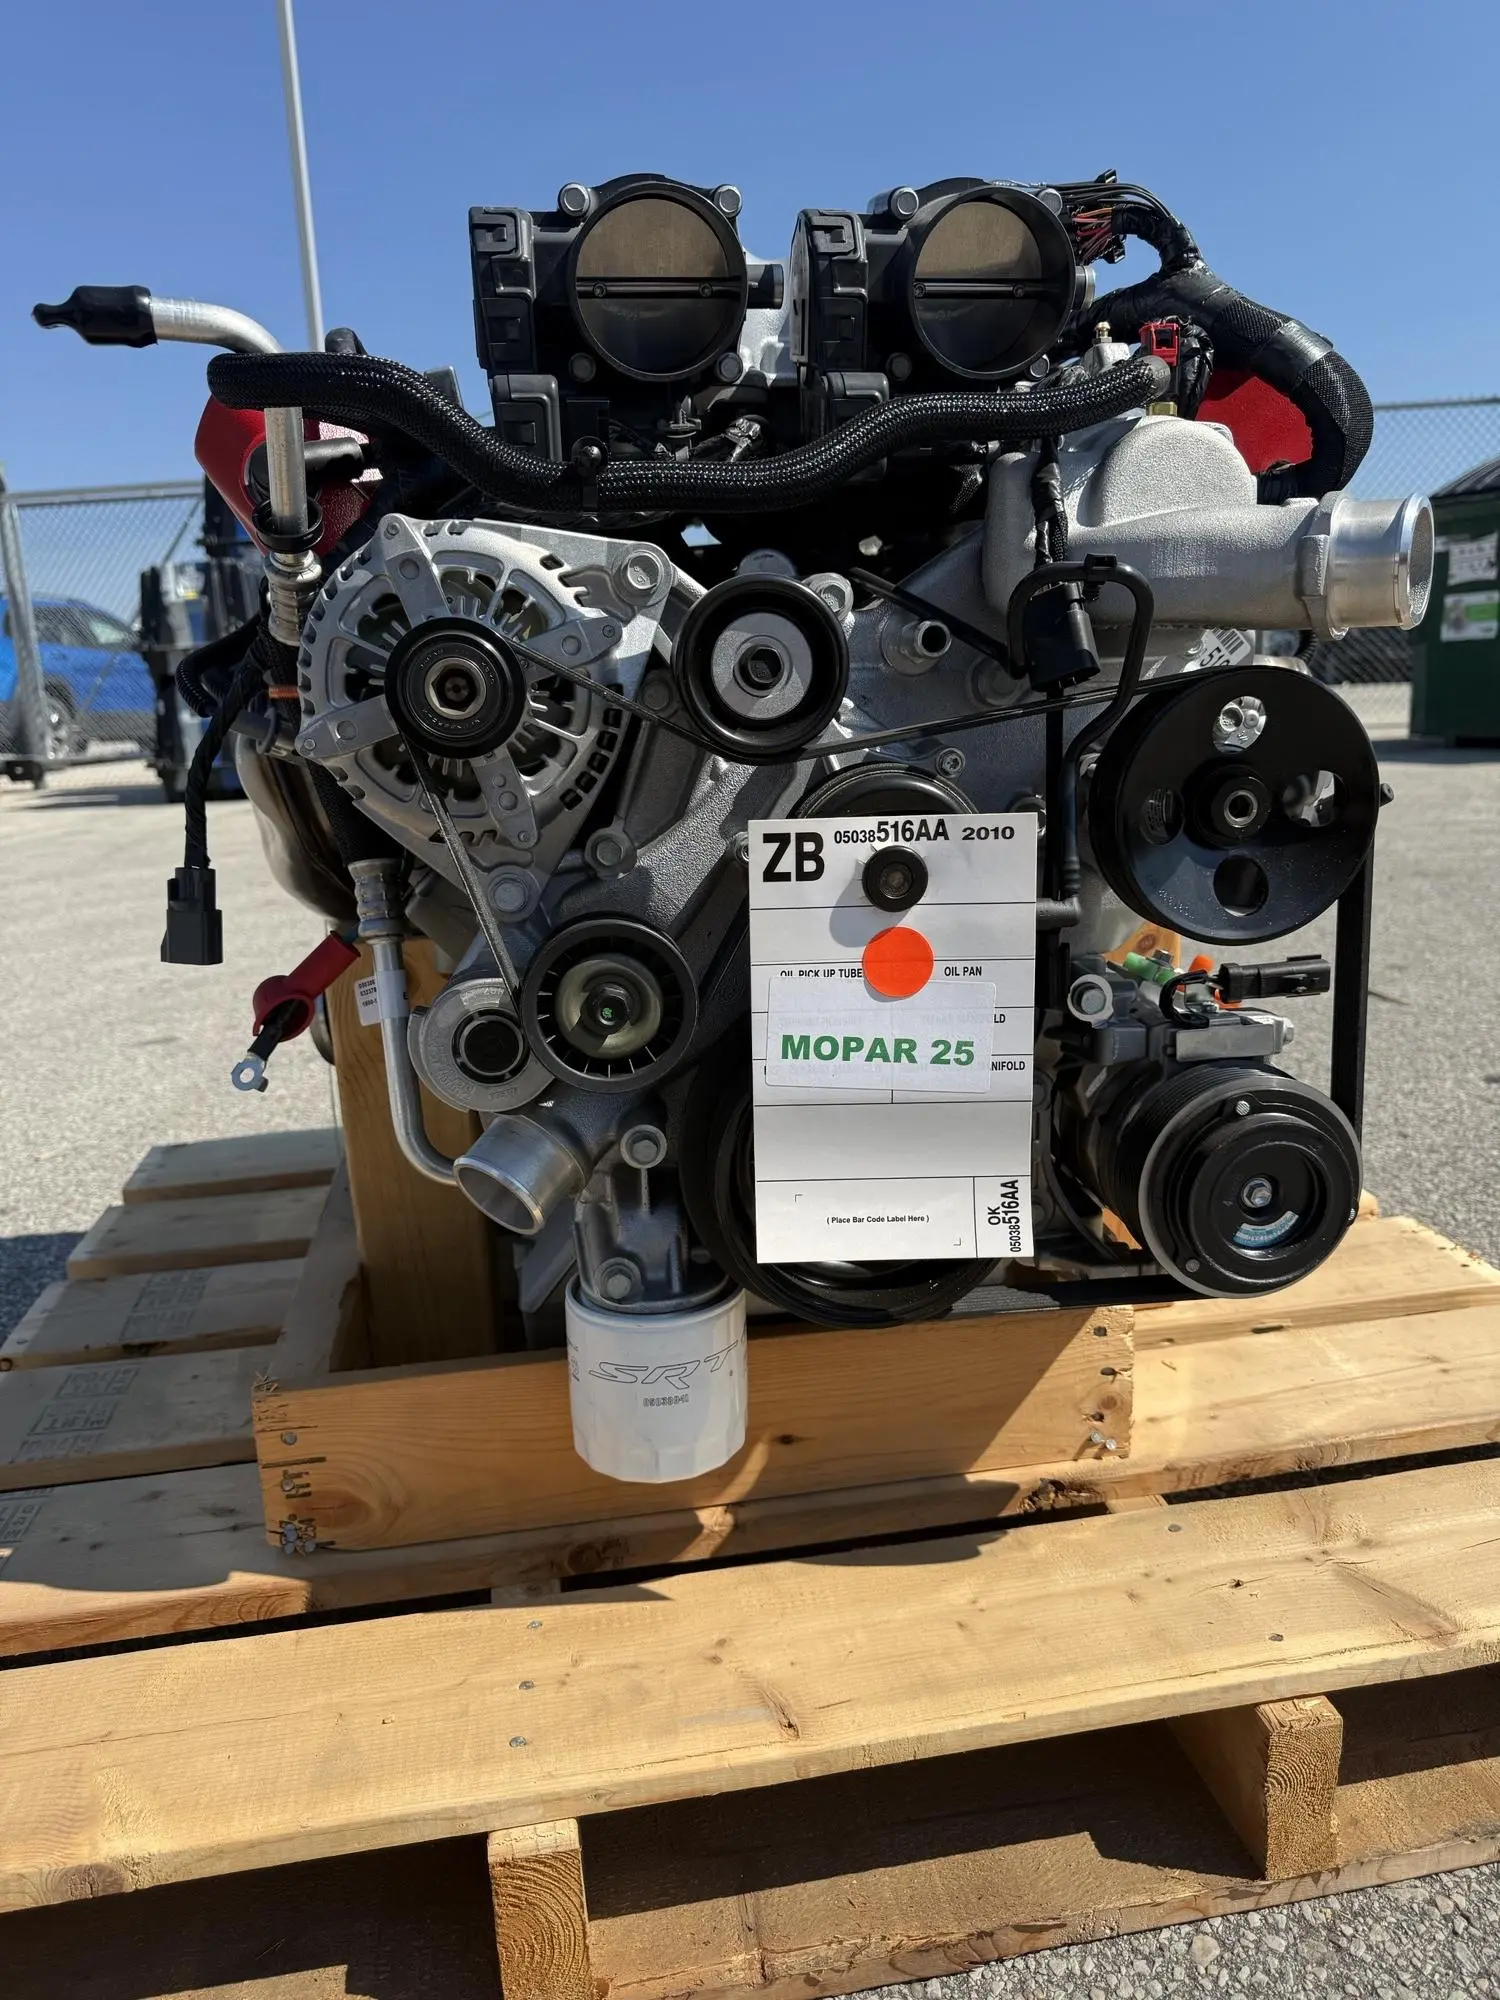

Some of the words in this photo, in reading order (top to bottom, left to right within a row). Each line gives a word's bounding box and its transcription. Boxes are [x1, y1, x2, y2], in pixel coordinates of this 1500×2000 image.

[762, 831, 825, 883] ZB
[961, 826, 1015, 841] 2010
[838, 968, 863, 978] TUBE
[944, 966, 960, 977] OIL
[962, 966, 982, 977] PAN
[781, 1034, 918, 1064] MOPAR
[929, 1039, 975, 1066] 25
[831, 1216, 851, 1224] Place
[852, 1216, 865, 1224] Bar
[866, 1215, 885, 1223] Code
[886, 1215, 907, 1223] Label
[987, 1205, 1001, 1226] OK
[588, 1340, 739, 1391] SRT
